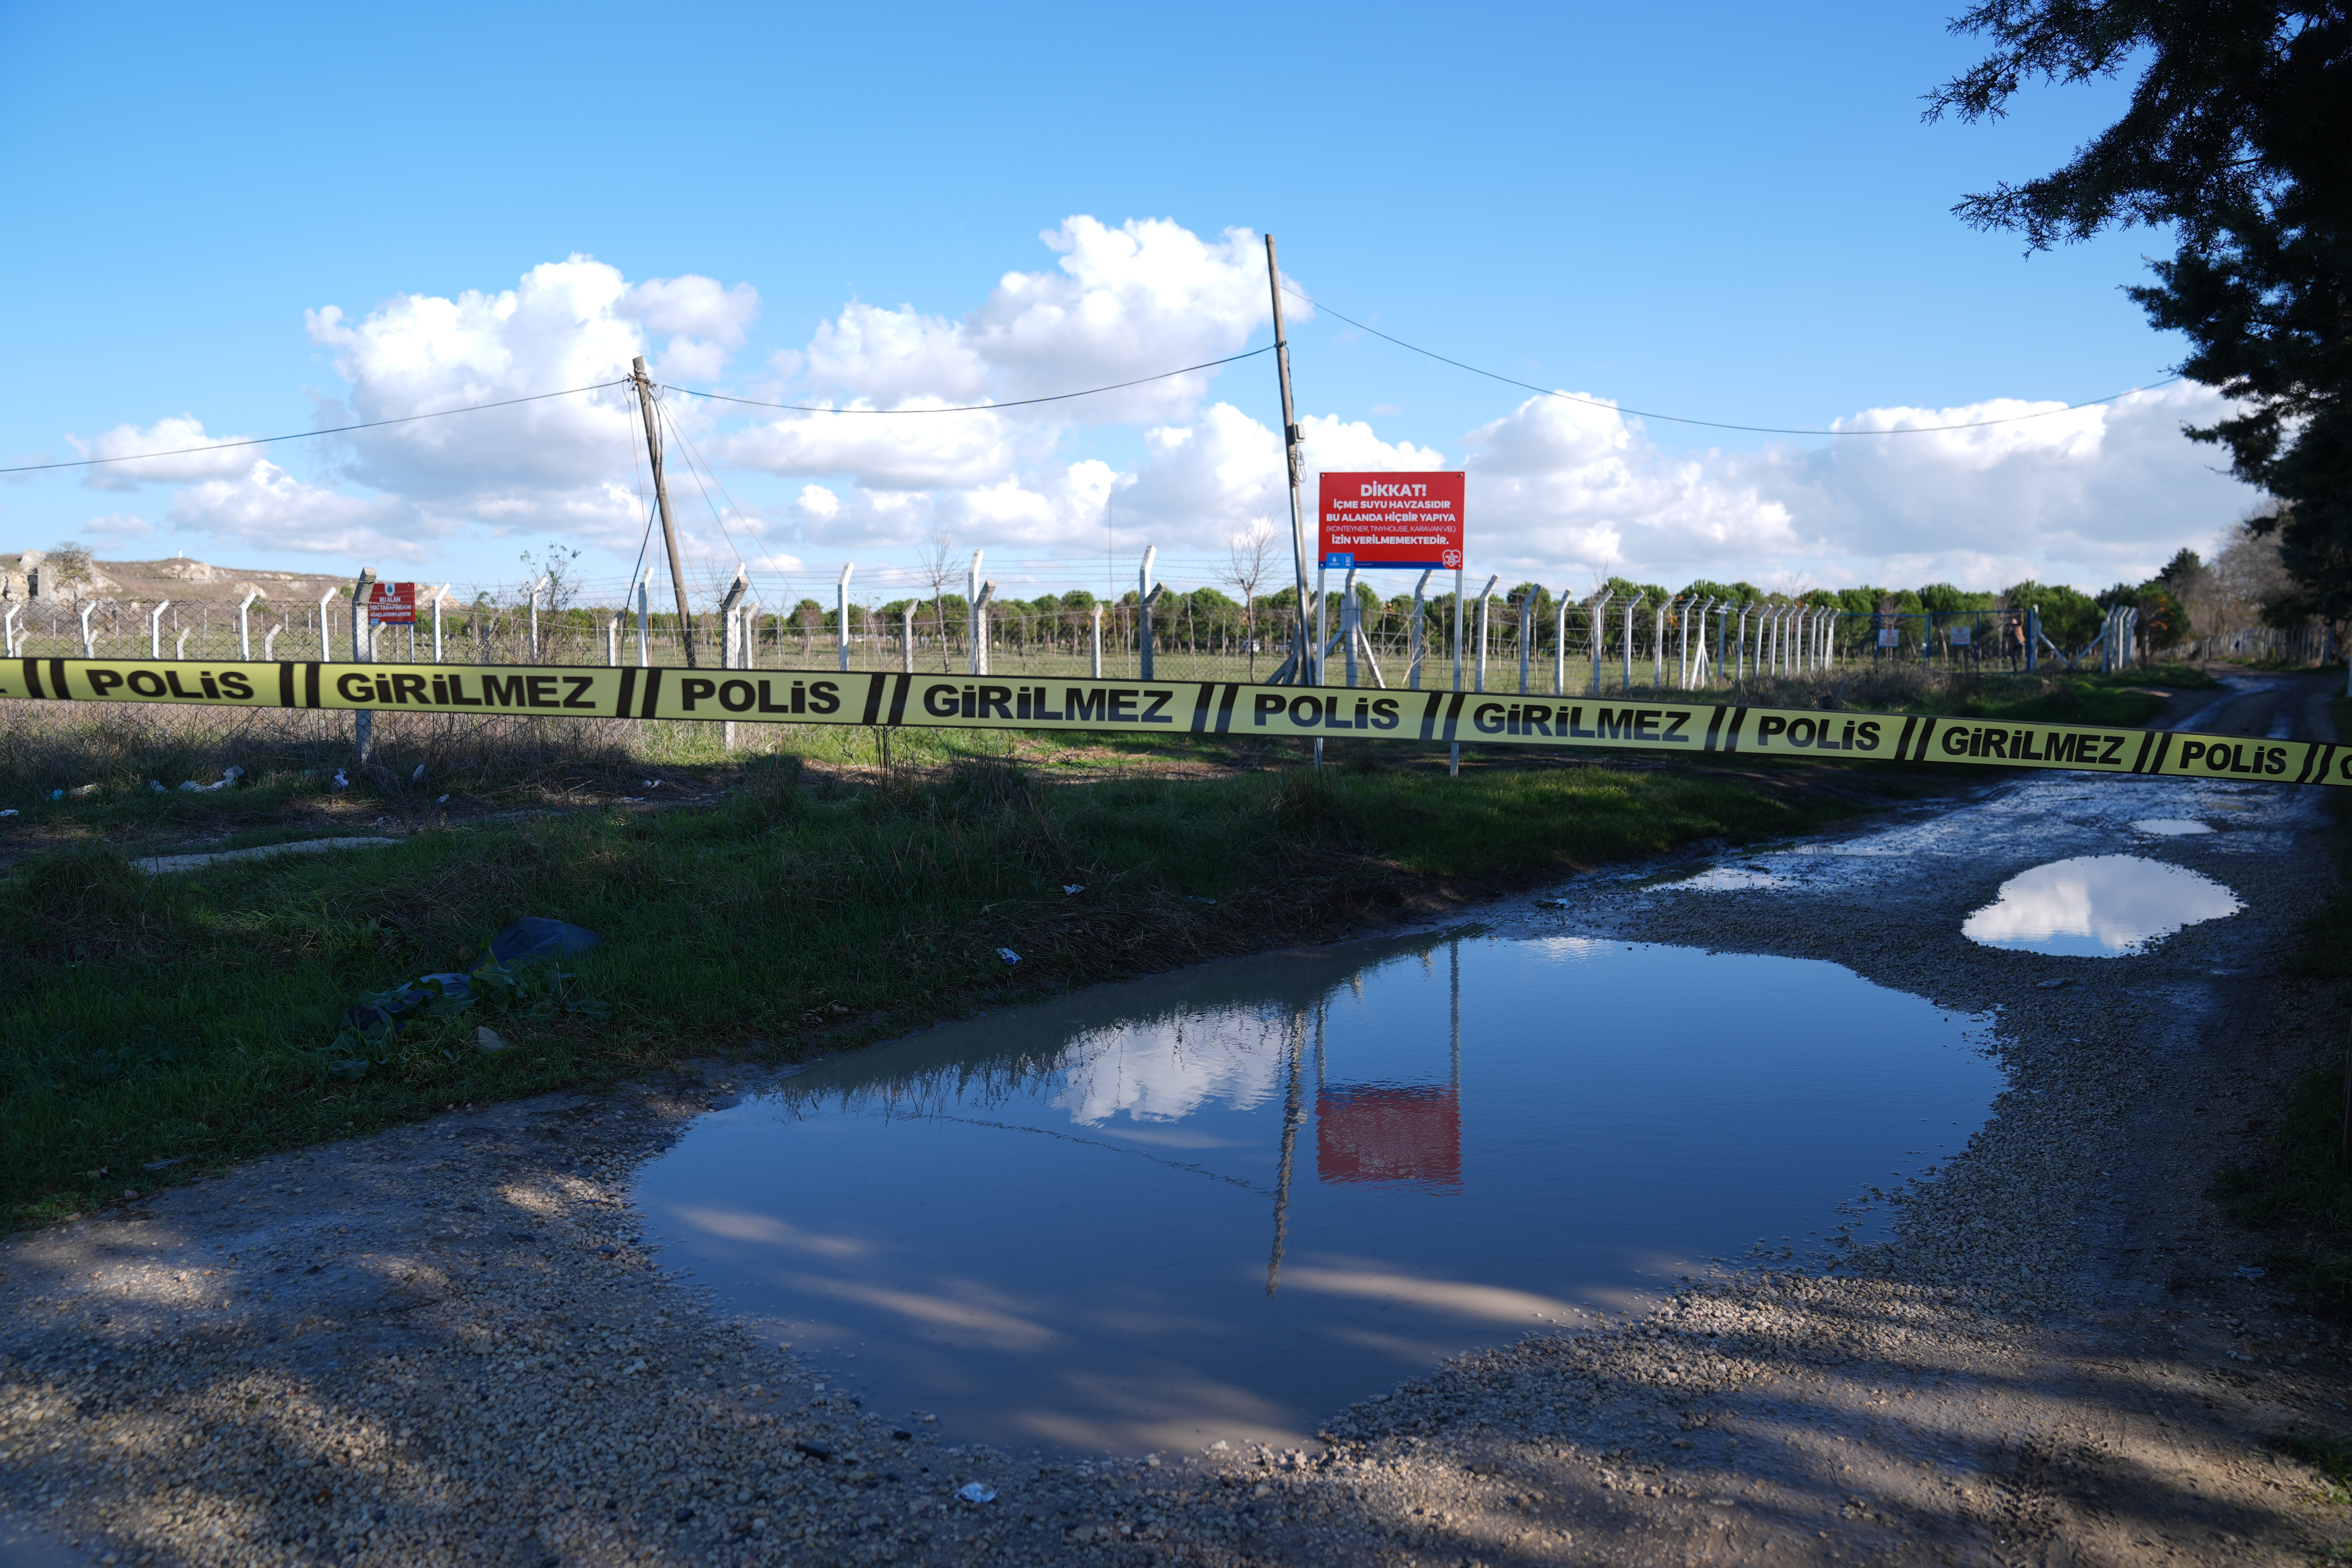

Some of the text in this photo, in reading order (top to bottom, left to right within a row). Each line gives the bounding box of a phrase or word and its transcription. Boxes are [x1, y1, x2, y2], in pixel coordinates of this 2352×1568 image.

[1361, 480, 1426, 497] DİKKAT!
[1333, 498, 1451, 510] İÇME SUYU HAVZASIDIR
[1326, 511, 1456, 523] BU ALANDA HİÇBİR YAPIYA
[1332, 534, 1450, 545] İZİN VERİLMEMEKTEDİR.
